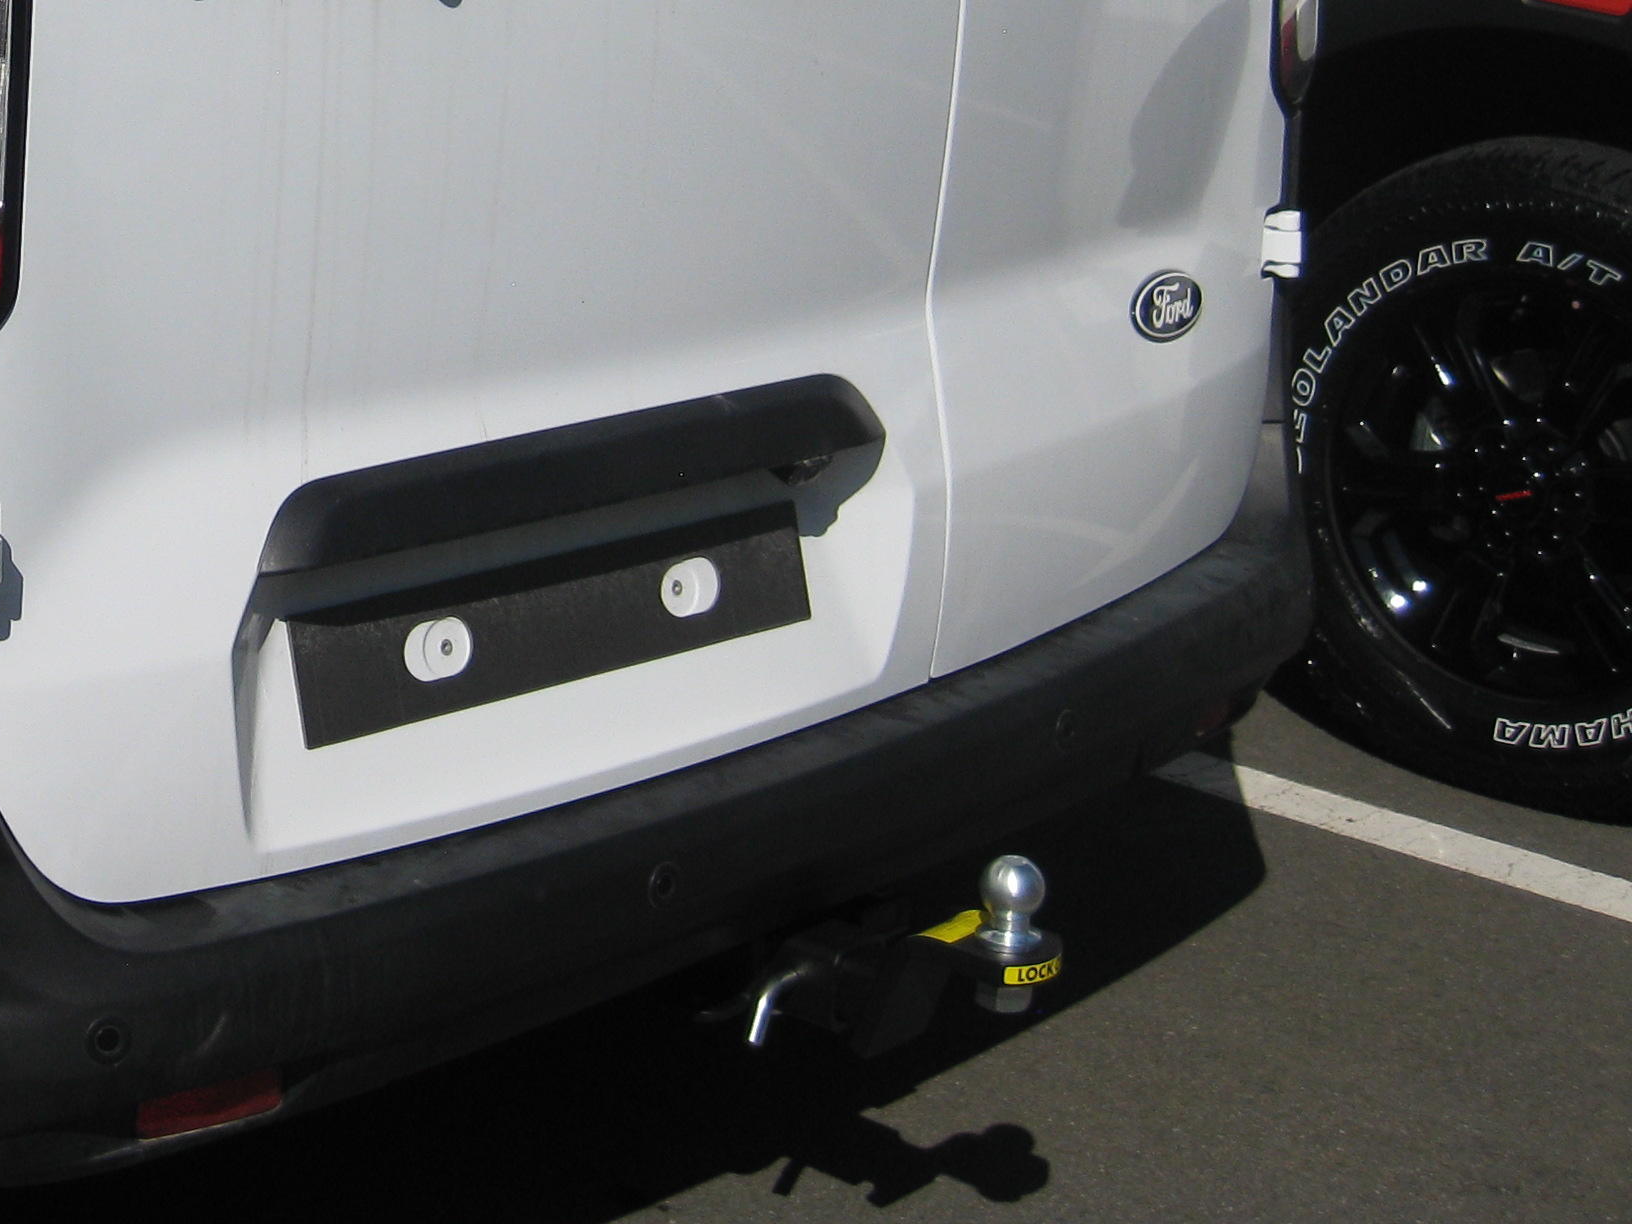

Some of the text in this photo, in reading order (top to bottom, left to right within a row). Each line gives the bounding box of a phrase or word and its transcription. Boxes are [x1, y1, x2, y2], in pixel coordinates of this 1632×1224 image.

[1152, 281, 1195, 330] Ford
[1290, 238, 1623, 475] OLANDAR A/T
